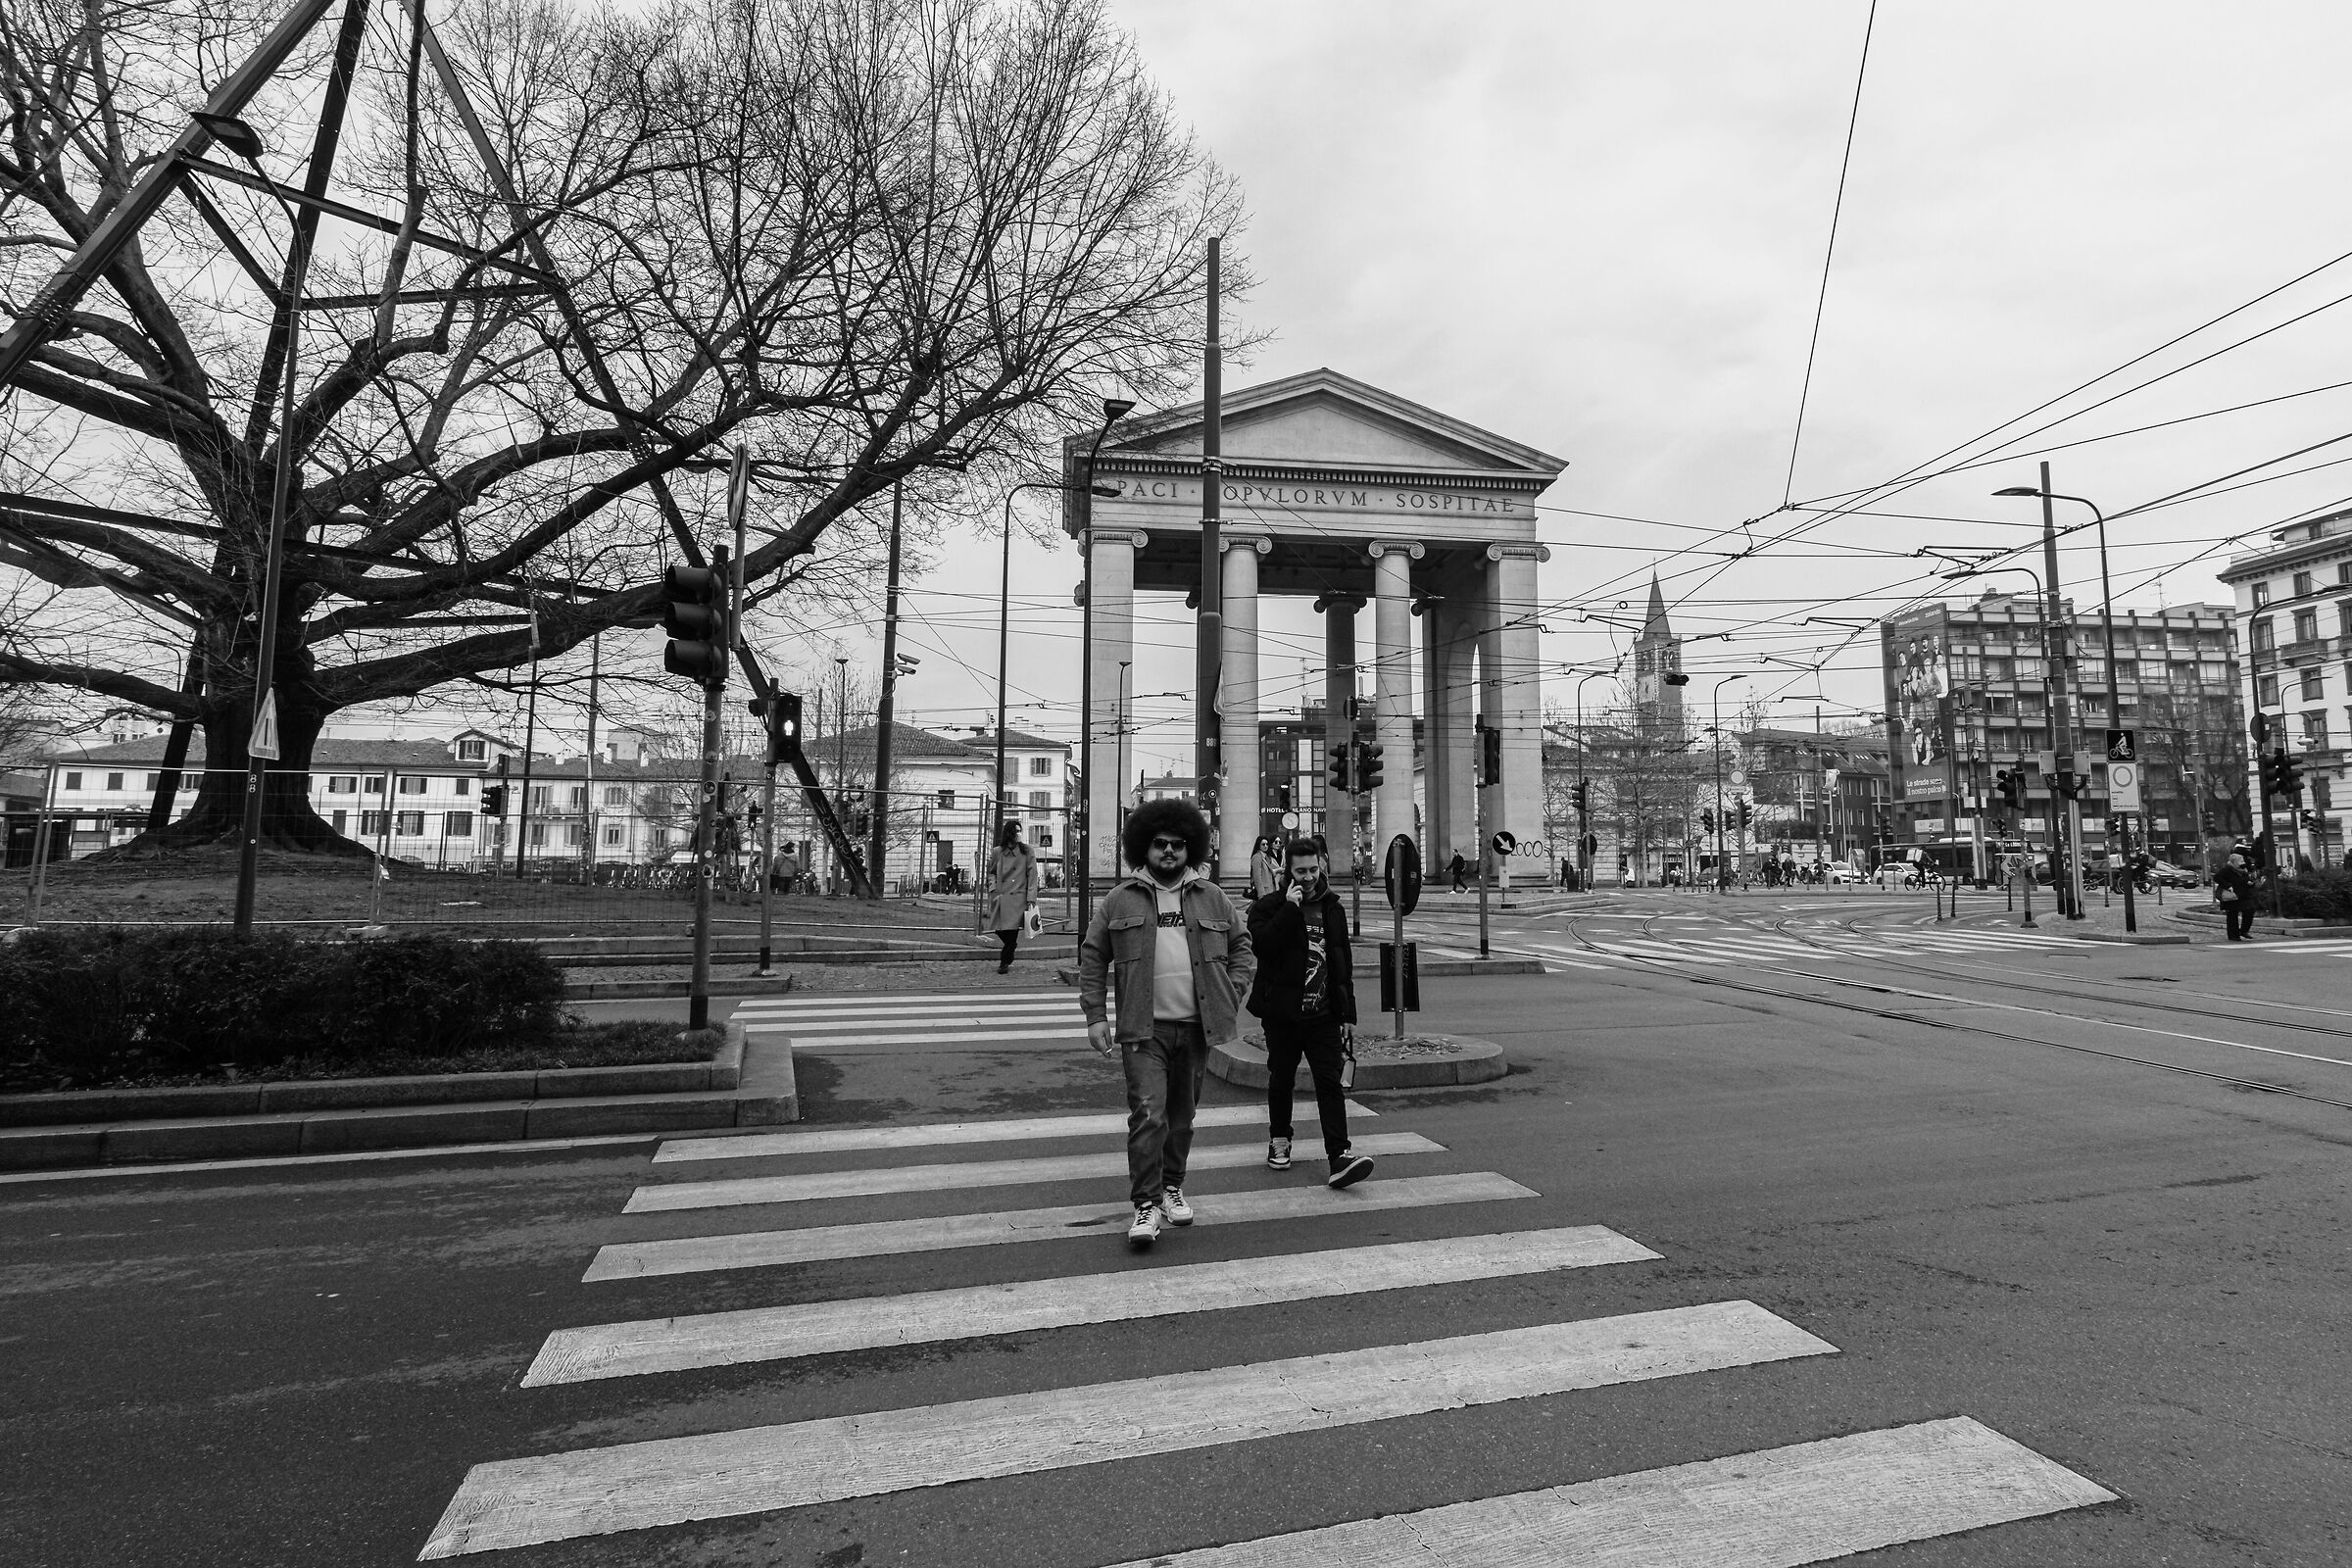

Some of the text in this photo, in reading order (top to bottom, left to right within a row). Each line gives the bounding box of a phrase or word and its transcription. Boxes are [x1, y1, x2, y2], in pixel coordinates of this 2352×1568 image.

[1116, 479, 1514, 513] PACI OPVLORVM SOSPITAE
[249, 773, 258, 794] 88
[1510, 840, 1544, 858] OCO
